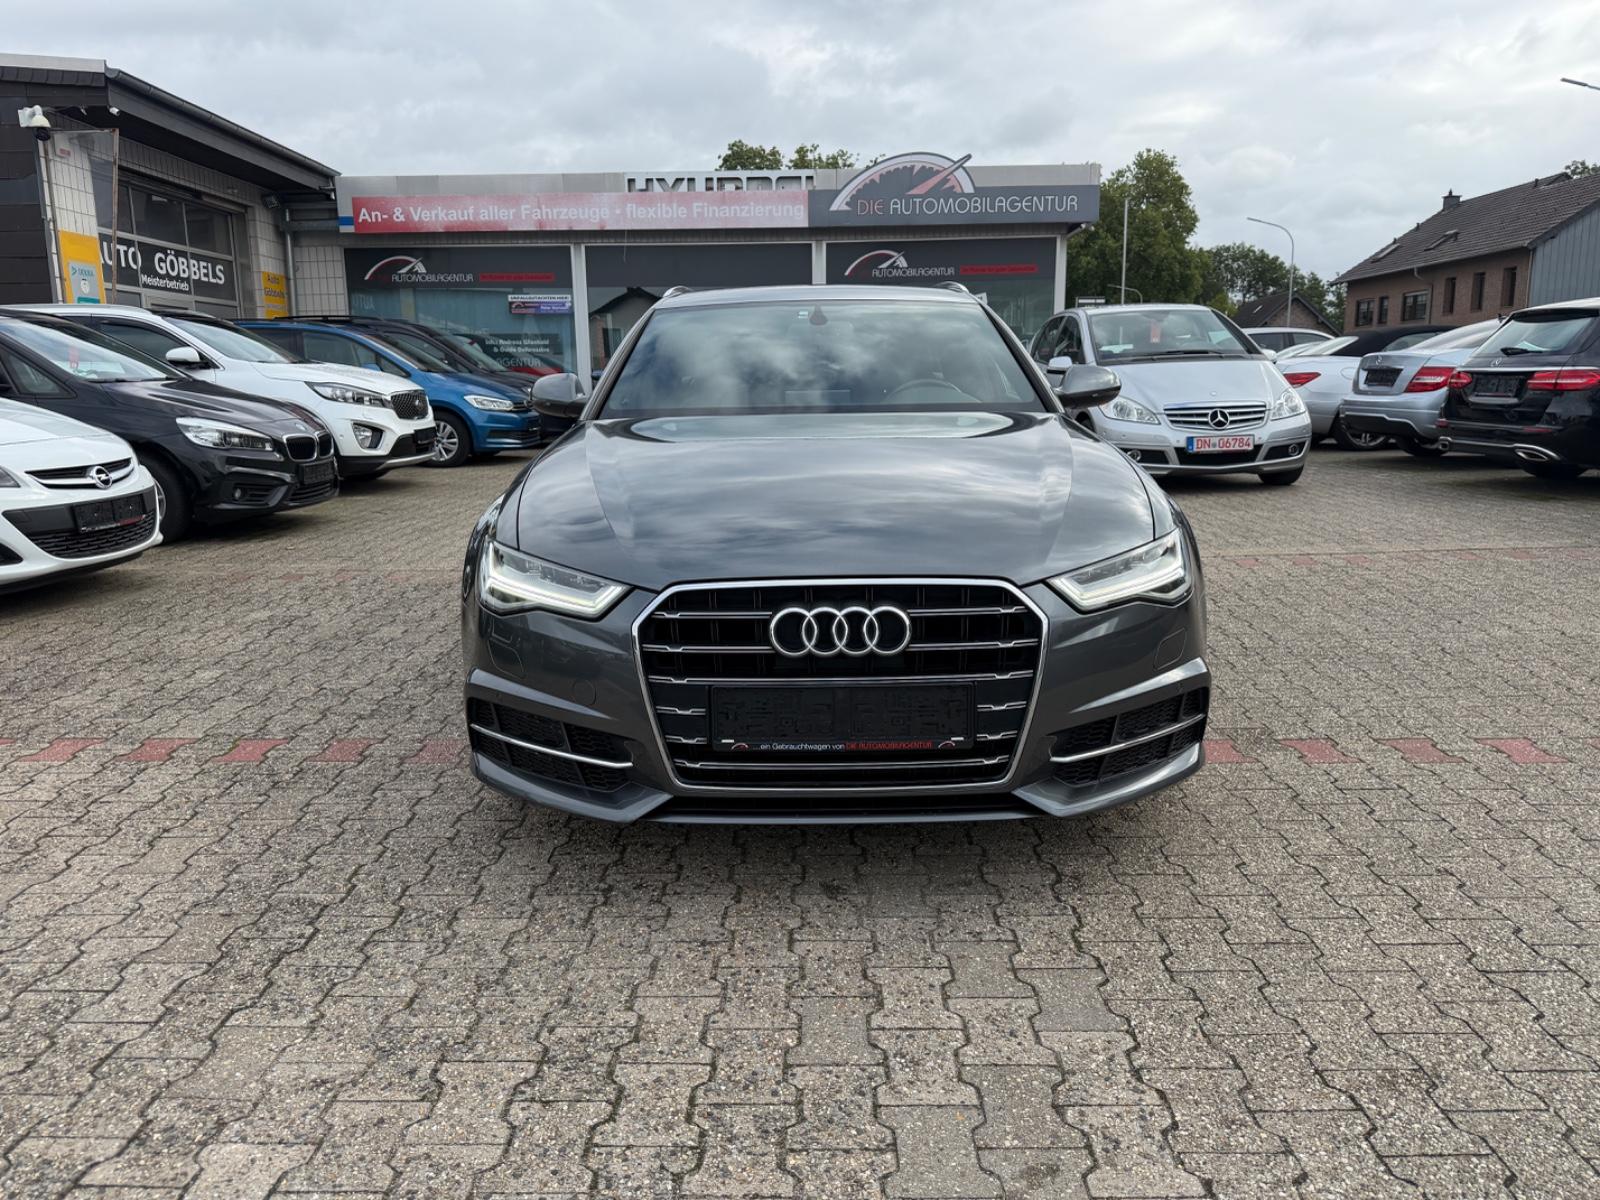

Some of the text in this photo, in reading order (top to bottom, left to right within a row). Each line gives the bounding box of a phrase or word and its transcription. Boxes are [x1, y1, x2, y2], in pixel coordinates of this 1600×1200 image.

[857, 195, 1079, 215] DIE AUTOMOBILAGENTUR
[358, 202, 805, 223] An- & Verkauf aller Fahrzeuge flexible Finanzierung
[100, 241, 225, 285] UTO GÖBBELS
[391, 273, 474, 283] AUTOMOBILAGENTUR
[871, 266, 956, 278] AUTOMOBILAGENTUR
[141, 274, 190, 291] Meisterbetrieb
[1196, 437, 1251, 449] DN 06784
[771, 742, 831, 752] Gebrauchtwagen
[832, 742, 845, 751] von
